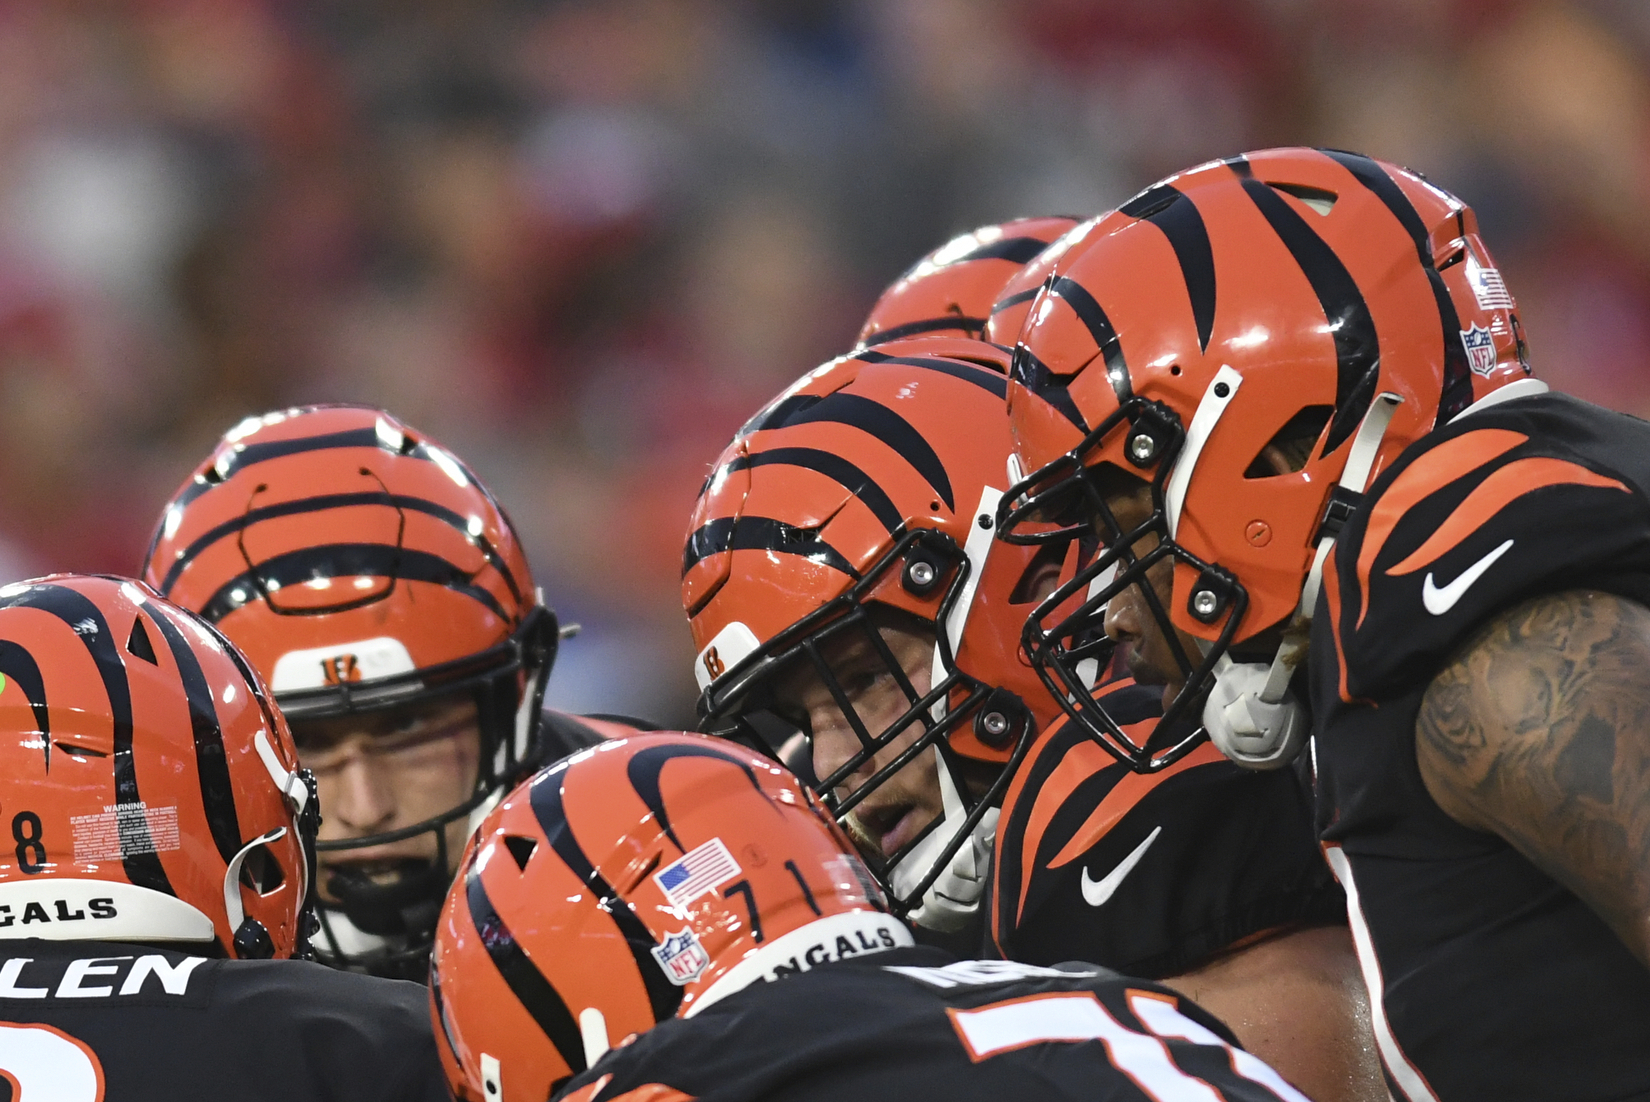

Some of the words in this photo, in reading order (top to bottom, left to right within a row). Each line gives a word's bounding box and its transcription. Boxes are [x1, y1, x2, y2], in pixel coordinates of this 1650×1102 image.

[103, 801, 147, 813] WARNING
[11, 810, 47, 875] 8
[723, 859, 823, 944] 71
[669, 949, 703, 978] NFL
[761, 927, 896, 981] NGALS
